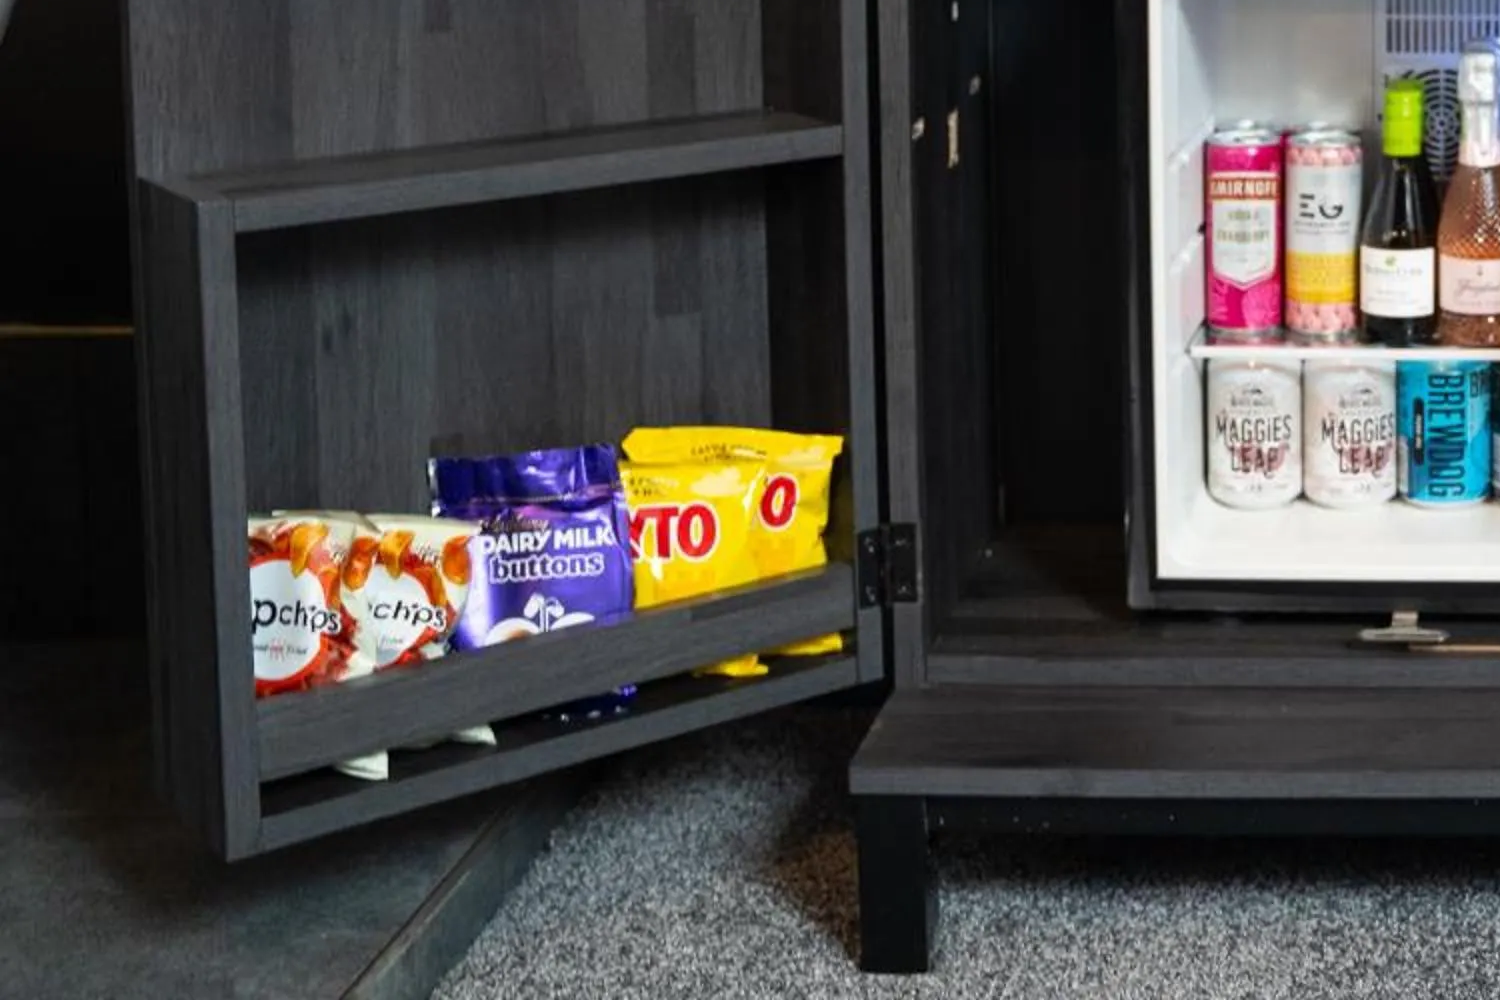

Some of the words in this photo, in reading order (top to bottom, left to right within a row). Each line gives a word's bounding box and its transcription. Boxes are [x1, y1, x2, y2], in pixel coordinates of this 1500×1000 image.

[1428, 373, 1468, 498] BREWDOG
[480, 529, 549, 555] DAIRY
[553, 527, 614, 550] MILK
[490, 553, 604, 583] buttons
